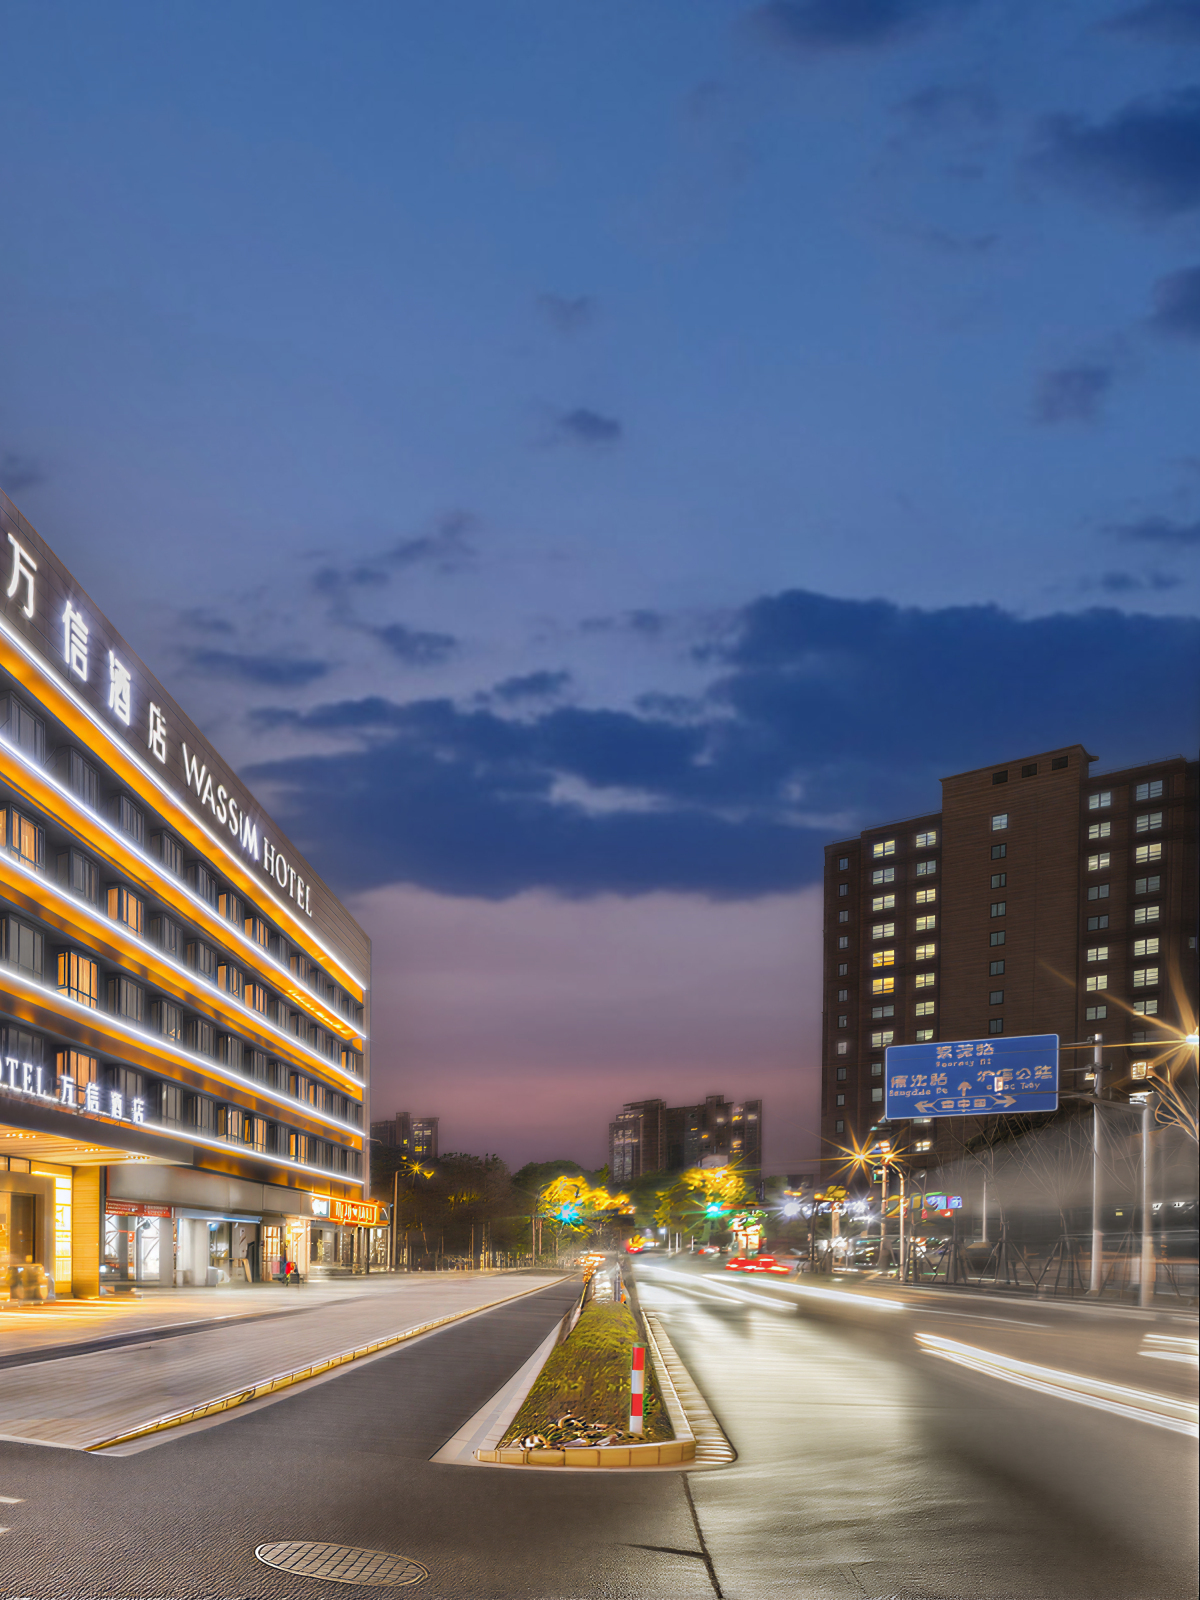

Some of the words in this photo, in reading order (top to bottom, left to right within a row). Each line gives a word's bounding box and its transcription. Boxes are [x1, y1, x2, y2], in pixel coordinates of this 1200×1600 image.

[7, 532, 167, 764] 万信酒店
[182, 742, 260, 861] WASSIM
[263, 836, 313, 918] HOTEL
[60, 1075, 145, 1124] 万信酒店
